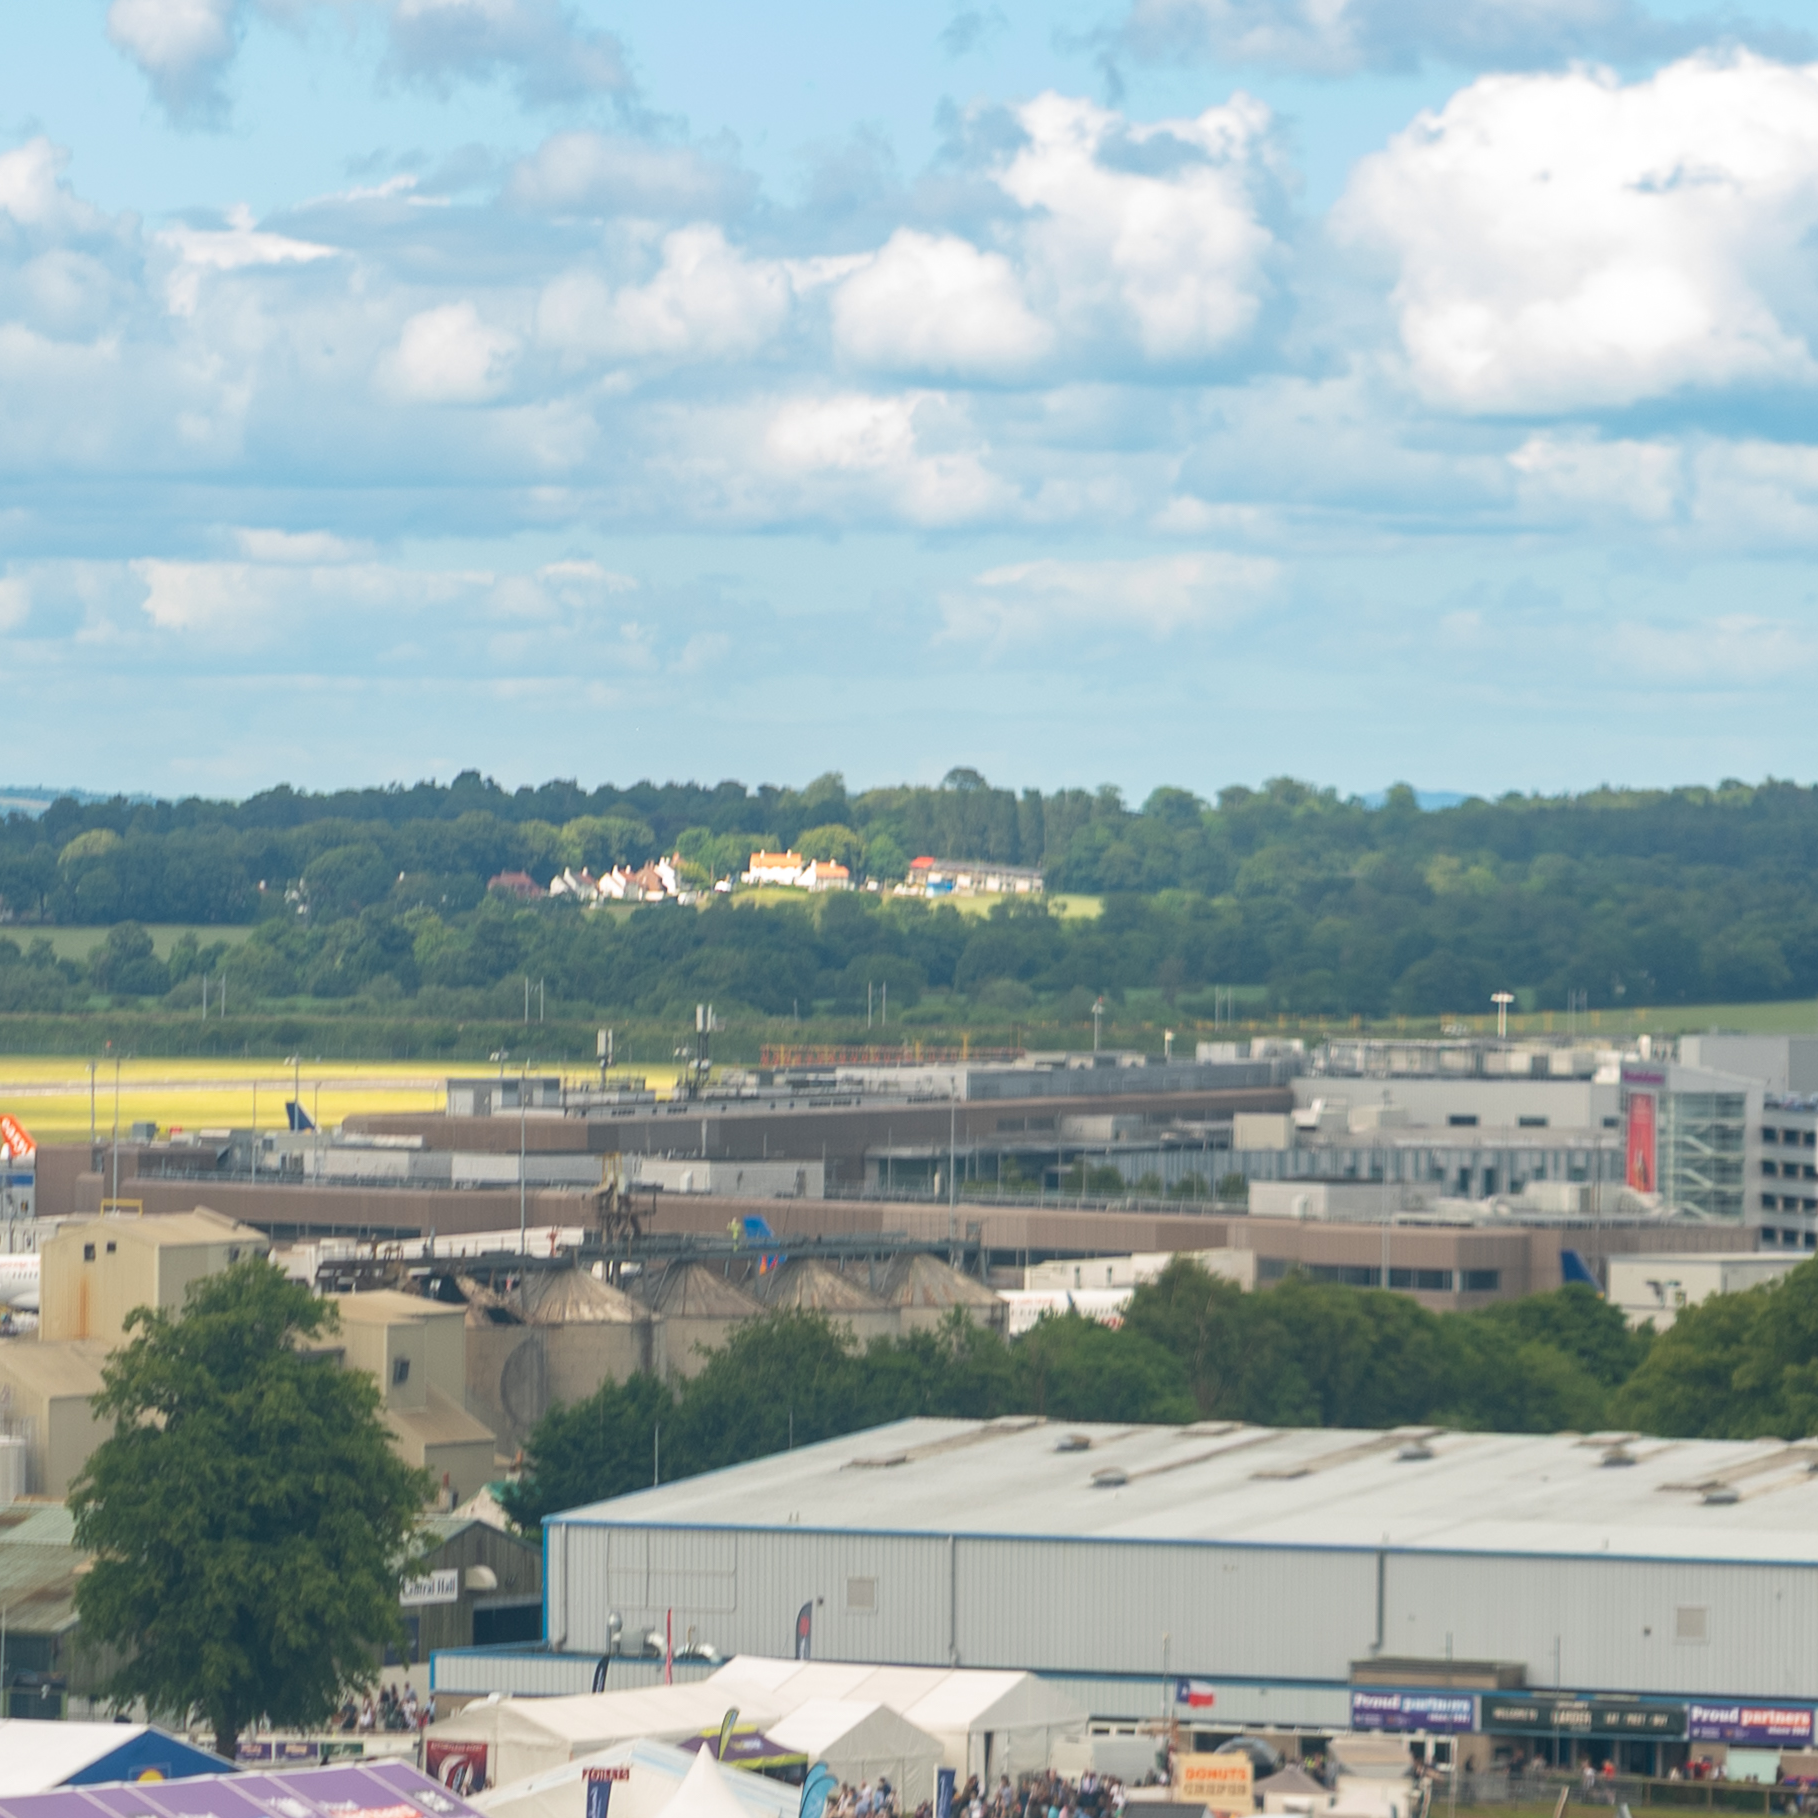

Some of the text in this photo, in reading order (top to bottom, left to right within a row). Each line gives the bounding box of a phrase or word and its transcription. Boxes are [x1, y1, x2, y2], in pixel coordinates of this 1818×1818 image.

[437, 1575, 457, 1594] Hall
[1691, 1705, 1812, 1727] Proud partners
[1185, 1766, 1247, 1781] DONUTS
